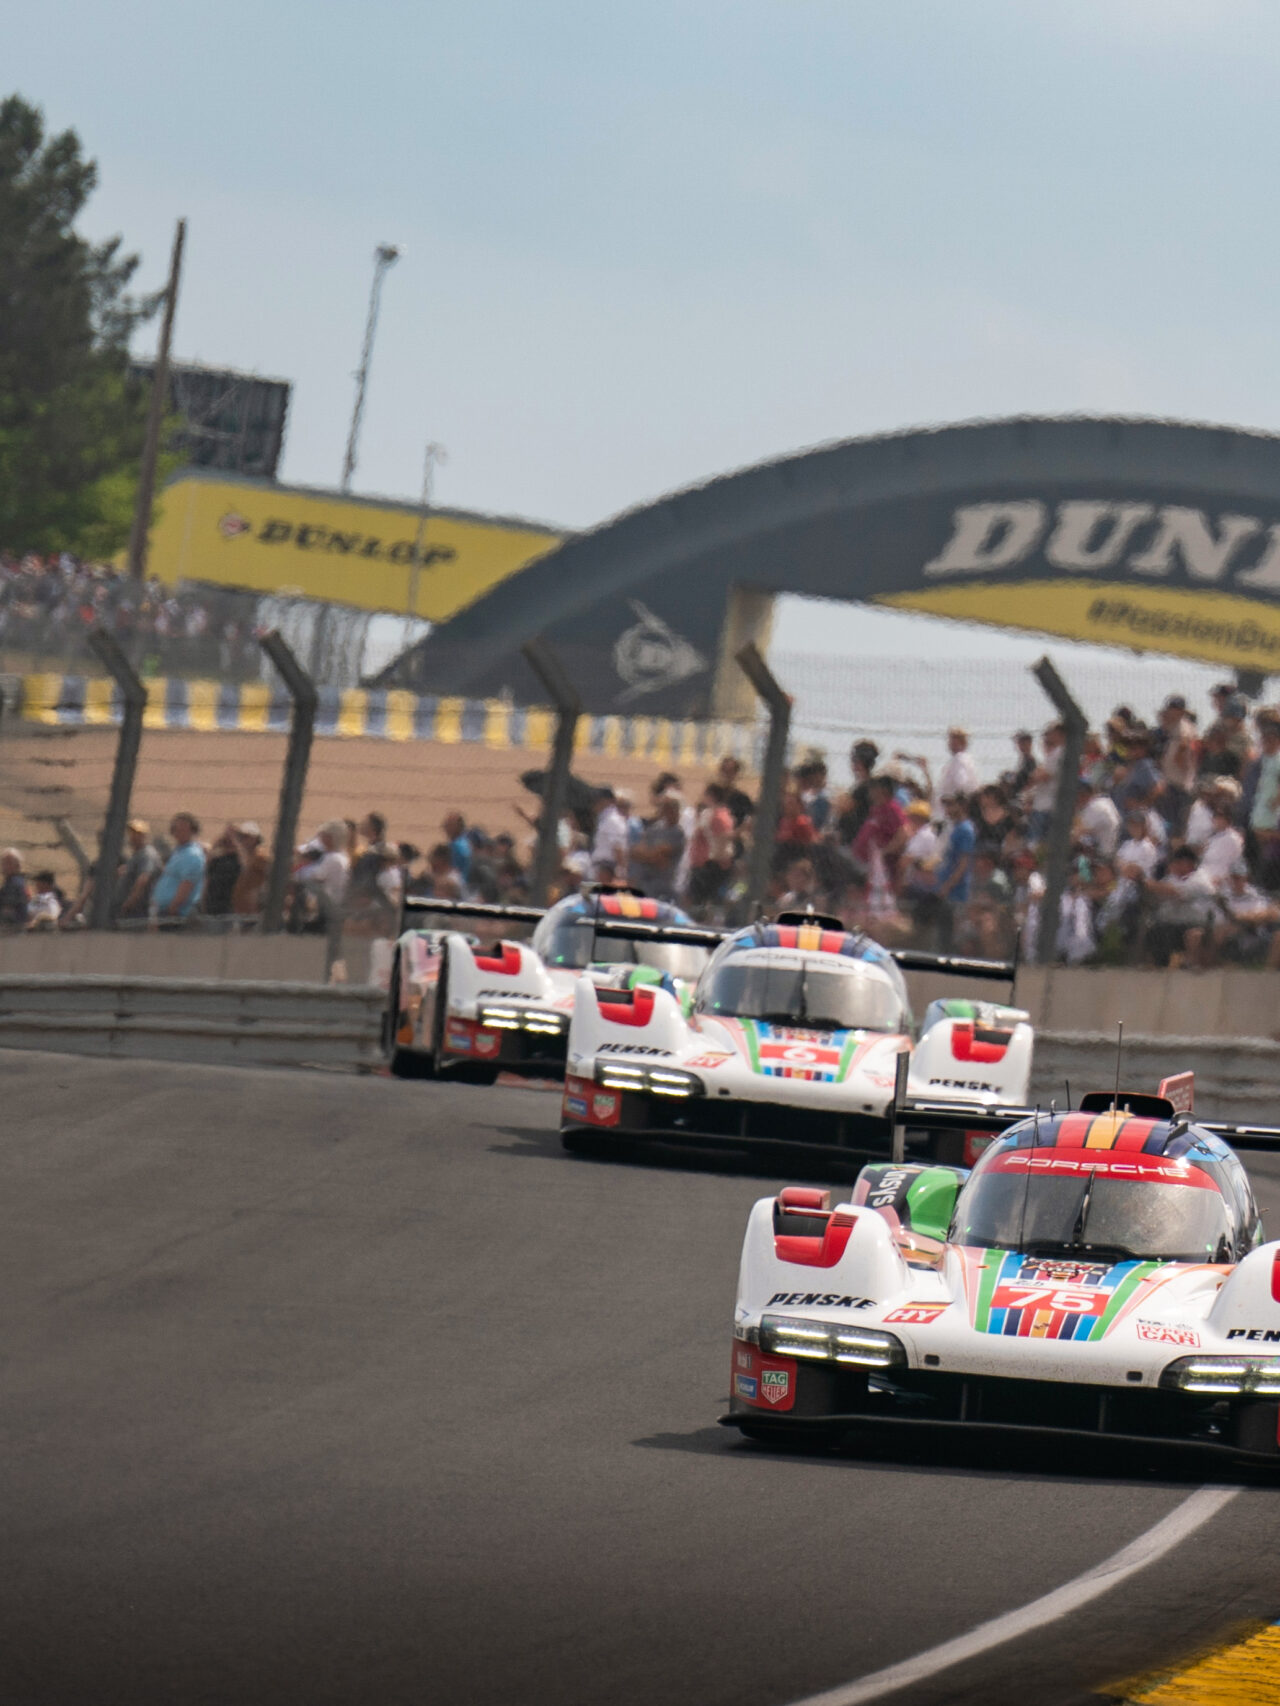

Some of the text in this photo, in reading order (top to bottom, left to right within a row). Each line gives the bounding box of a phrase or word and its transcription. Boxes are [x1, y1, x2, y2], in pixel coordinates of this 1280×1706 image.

[256, 517, 458, 567] DUNLOP
[783, 1047, 816, 1063] 6
[1004, 1156, 1190, 1179] PORSCHE
[766, 1292, 878, 1310] PENSKE
[1008, 1287, 1095, 1312] 75
[887, 1309, 935, 1322] HY
[1142, 1331, 1195, 1345] CAR
[764, 1374, 786, 1385] TAG
